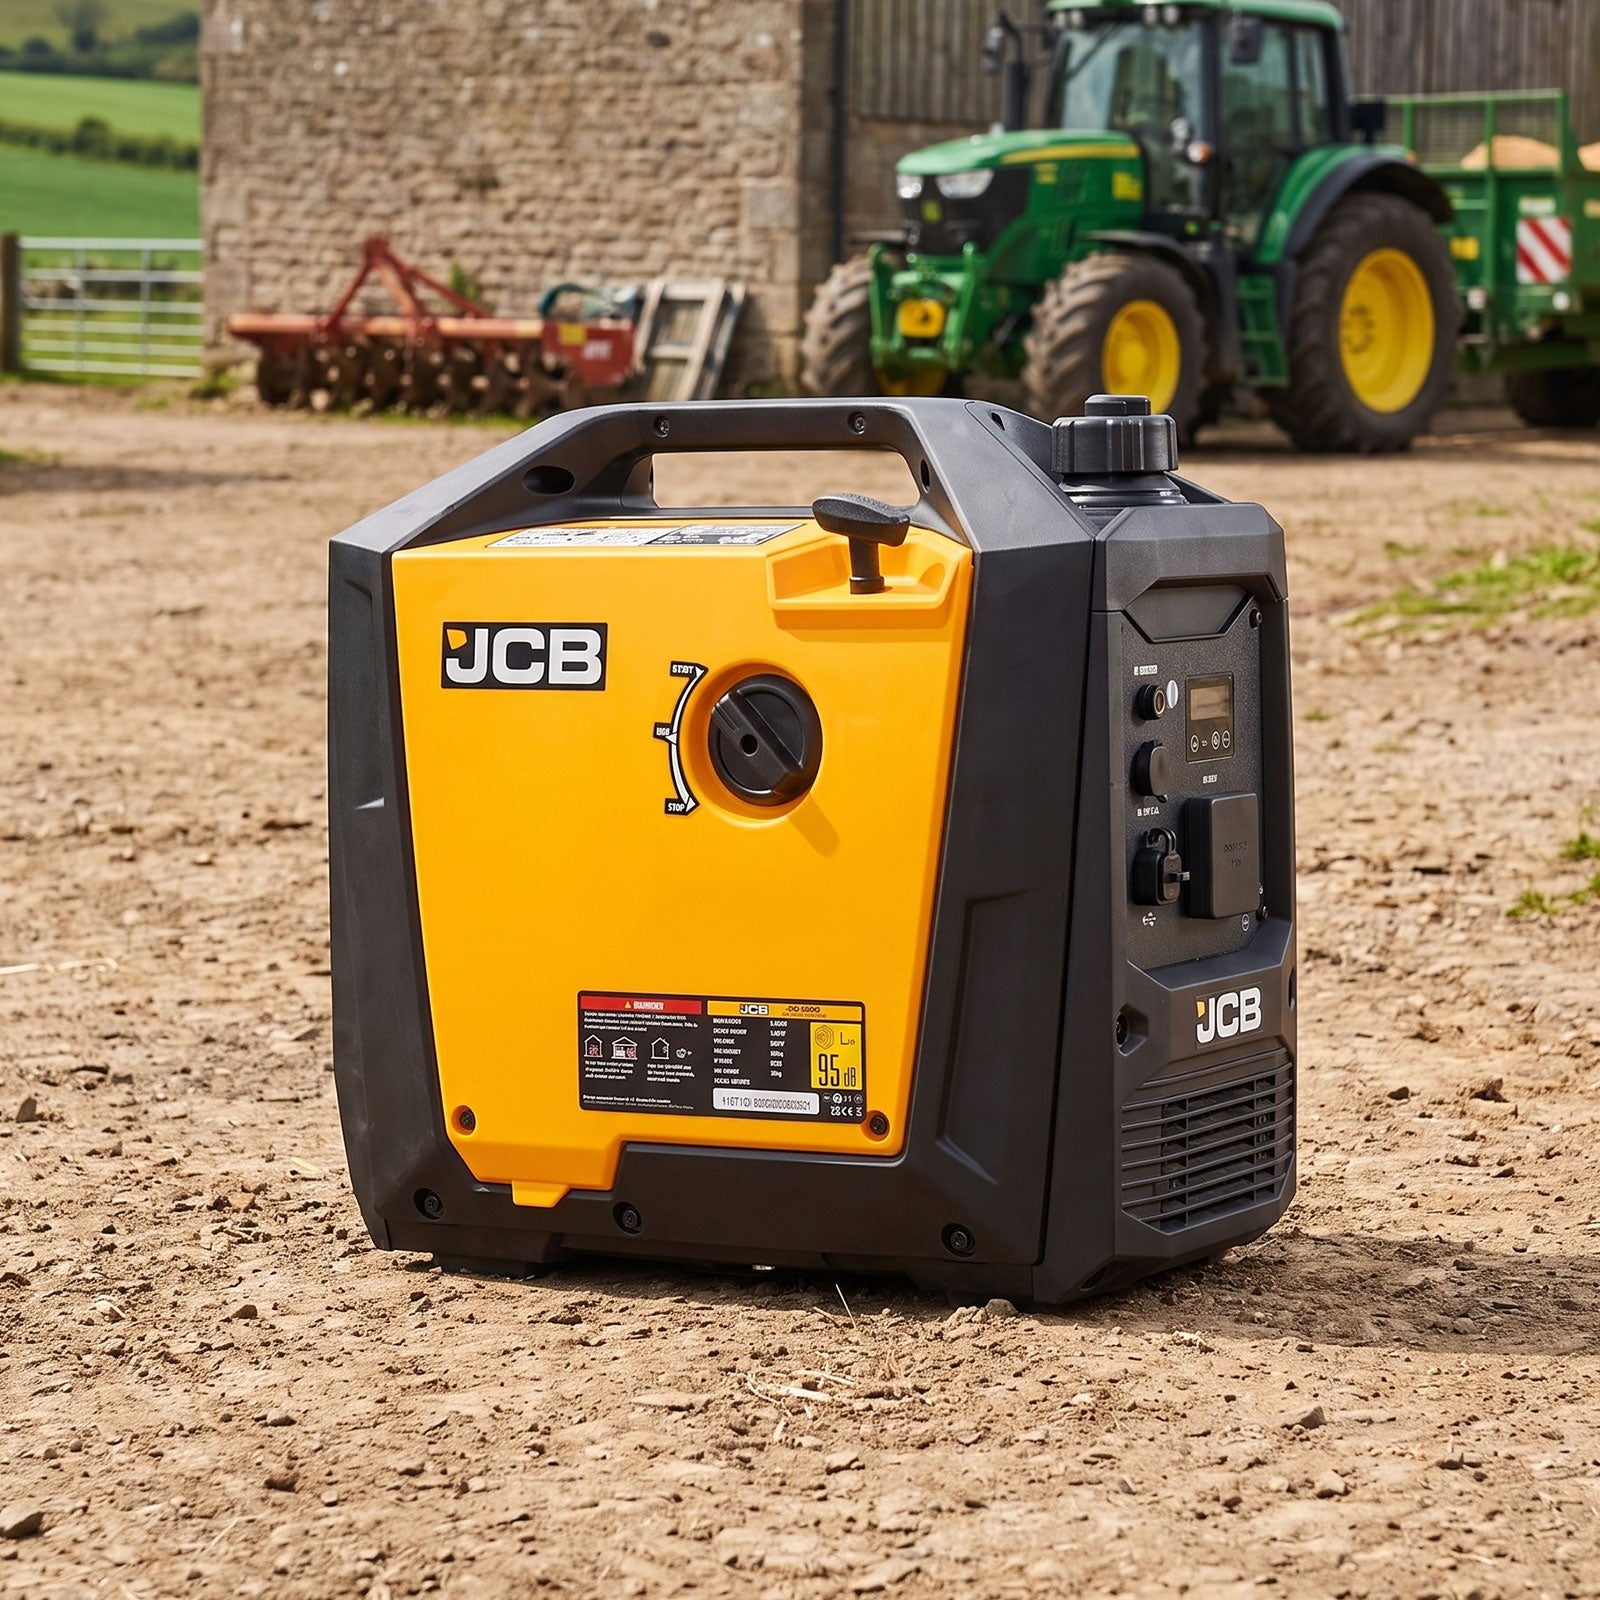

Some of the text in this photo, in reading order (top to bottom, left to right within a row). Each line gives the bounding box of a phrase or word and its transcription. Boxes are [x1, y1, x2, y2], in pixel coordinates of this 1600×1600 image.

[445, 627, 602, 684] JCB
[667, 803, 685, 812] STOP
[740, 1004, 768, 1015] JCB
[1196, 987, 1262, 1044] JCB
[818, 1053, 856, 1087] 95 dB
